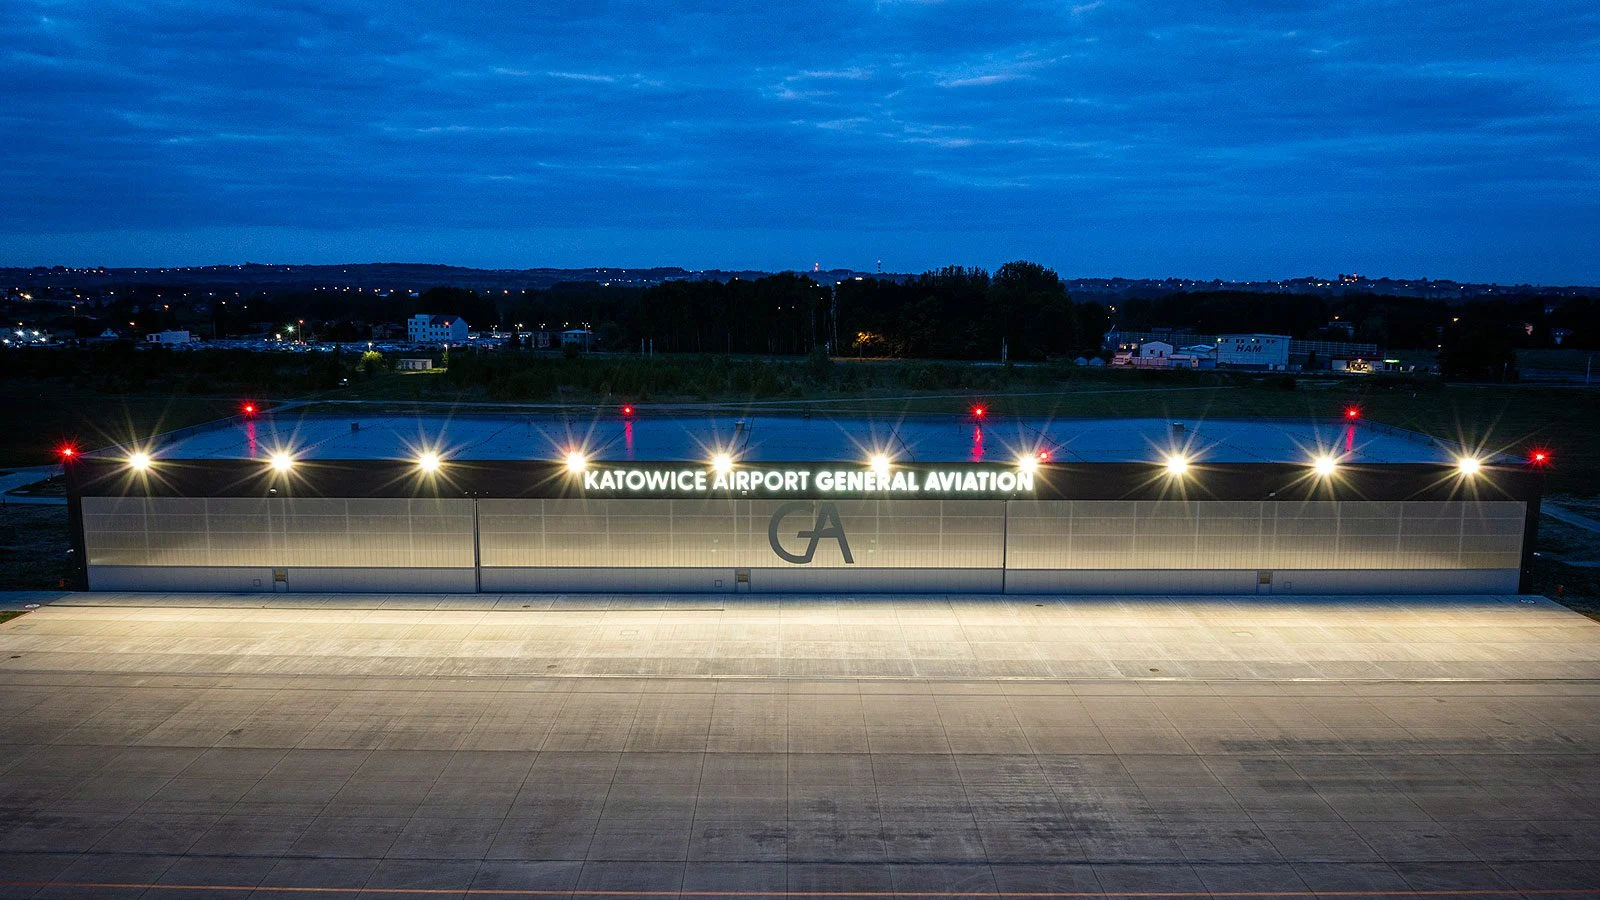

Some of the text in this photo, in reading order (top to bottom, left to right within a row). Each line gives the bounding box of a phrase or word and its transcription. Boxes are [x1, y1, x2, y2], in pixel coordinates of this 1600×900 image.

[584, 471, 1034, 492] KATOWICE AIRPORT GENERAL AVIATION
